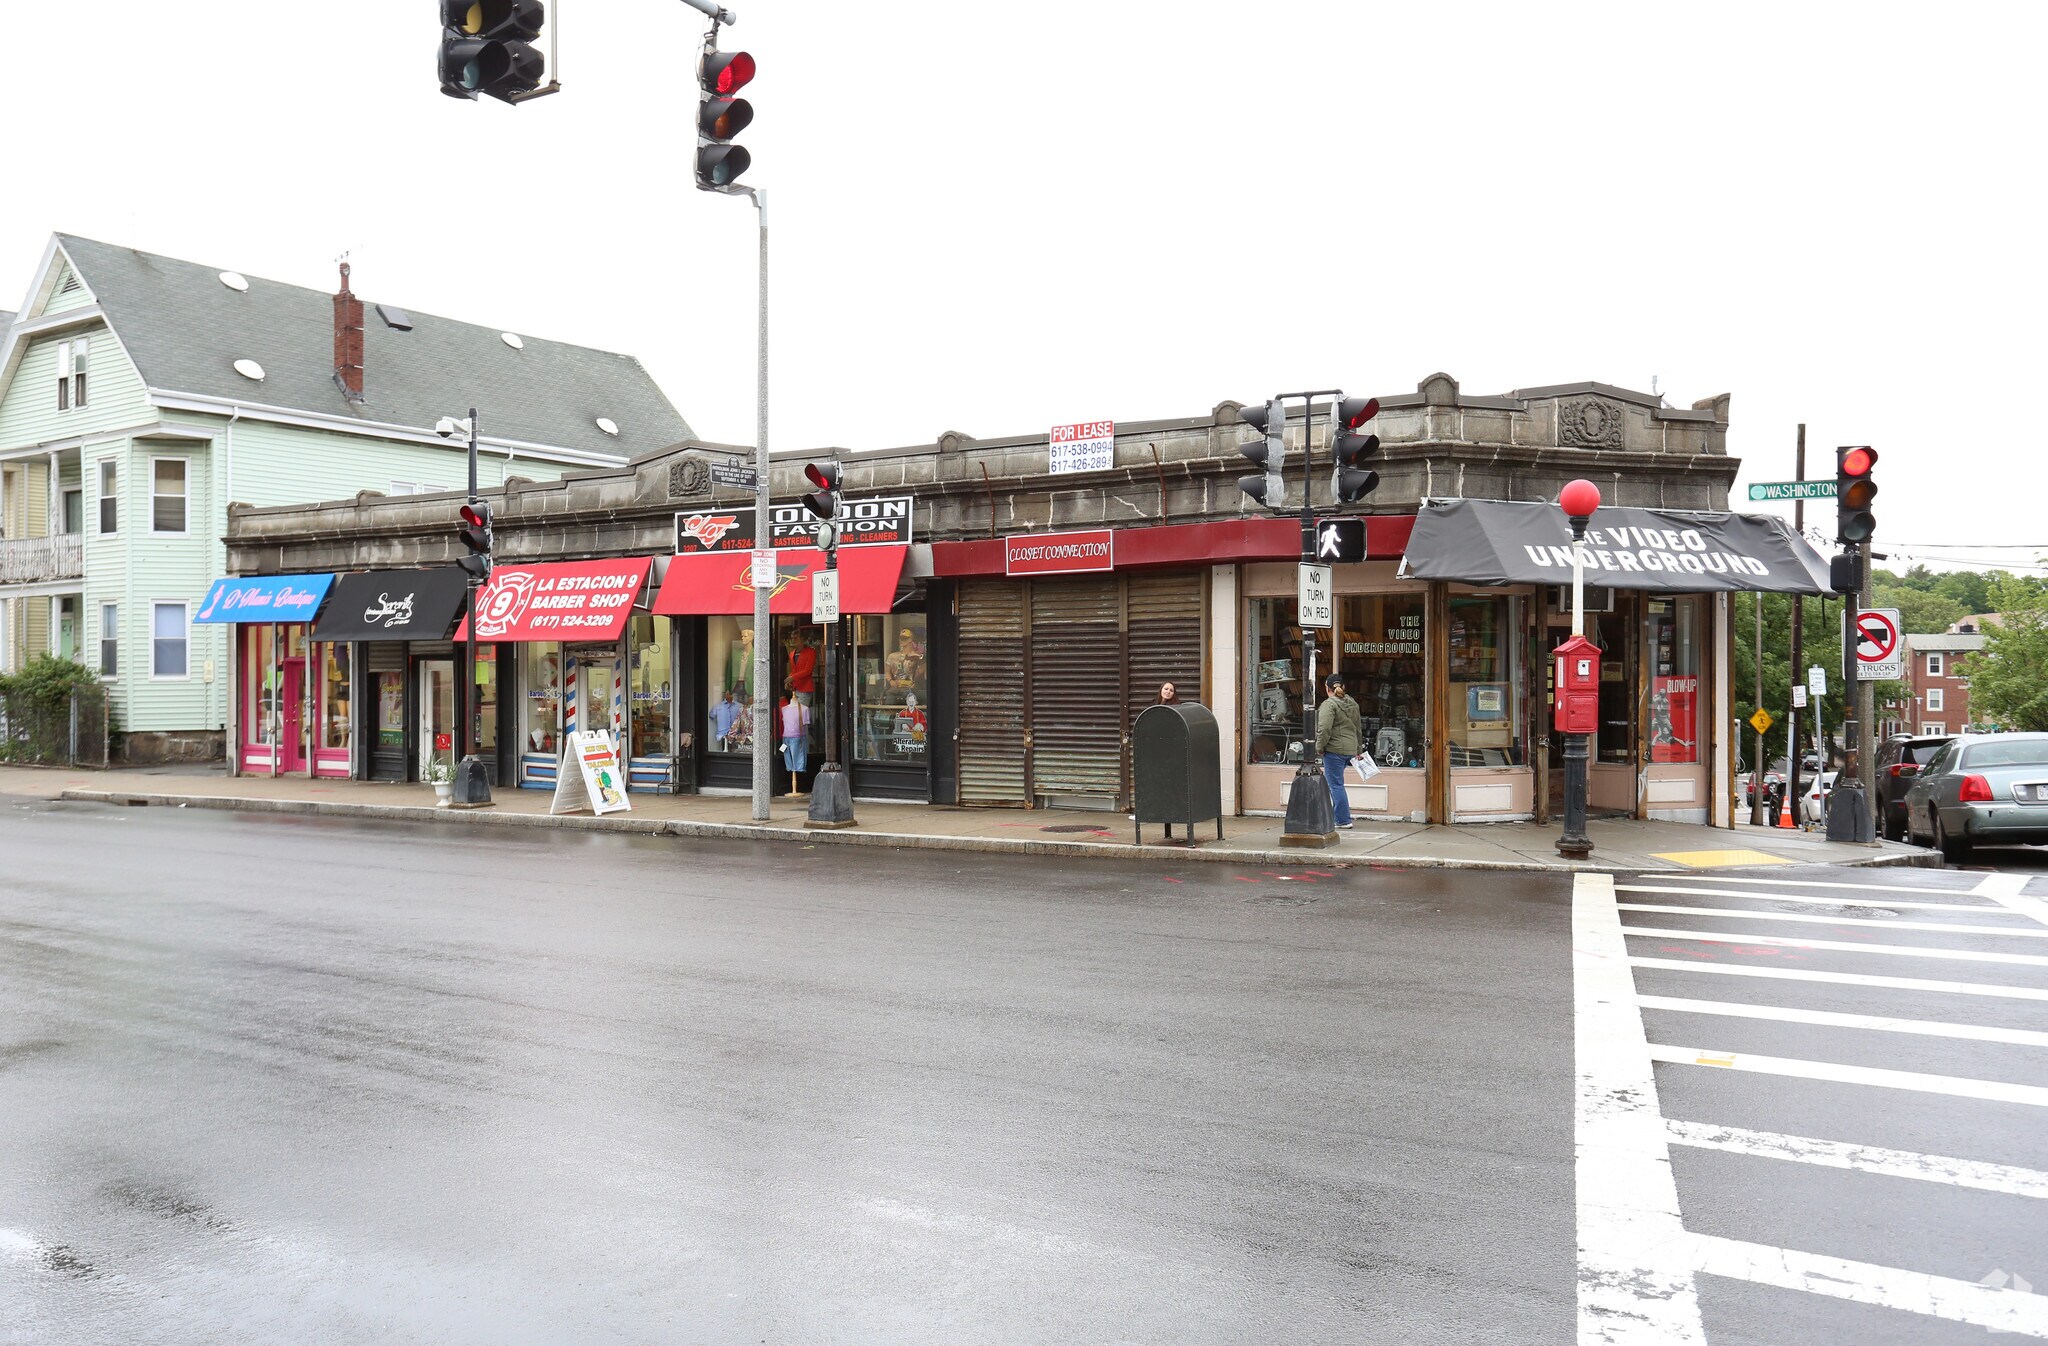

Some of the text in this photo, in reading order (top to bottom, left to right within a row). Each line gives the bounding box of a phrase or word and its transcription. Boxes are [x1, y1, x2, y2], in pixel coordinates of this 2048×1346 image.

[1053, 422, 1111, 441] FOR LEASE
[1051, 441, 1112, 458] 617-538-0994
[1766, 483, 1838, 498] WASHINGTON
[769, 501, 906, 523] ONDON
[774, 520, 898, 536] FASION
[860, 531, 898, 542] CLEANERS
[1605, 526, 1707, 552] VIDEO
[1009, 541, 1110, 563] CLOSET CONNECTION
[1523, 545, 1770, 576] UNDERGROUND
[536, 574, 638, 591] LA ESTACION 9
[821, 577, 830, 587] NO
[1309, 571, 1321, 584] NO
[530, 593, 630, 609] BARBER SHOP
[819, 591, 833, 602] TURN
[1306, 589, 1325, 601] TURN
[490, 591, 514, 617] 9
[814, 605, 837, 616] ON RED
[1302, 606, 1329, 619] ON RED
[530, 614, 614, 629] (617) 524-3209
[1400, 615, 1421, 627] THE
[1388, 628, 1421, 640] VIDEO
[1344, 642, 1421, 654] UNDERGROUND
[1863, 664, 1896, 672] TRUCKS
[1667, 679, 1696, 693] BLOW-UP
[529, 689, 545, 697] Barber
[633, 691, 651, 699] Barber
[901, 745, 925, 753] Repairs
